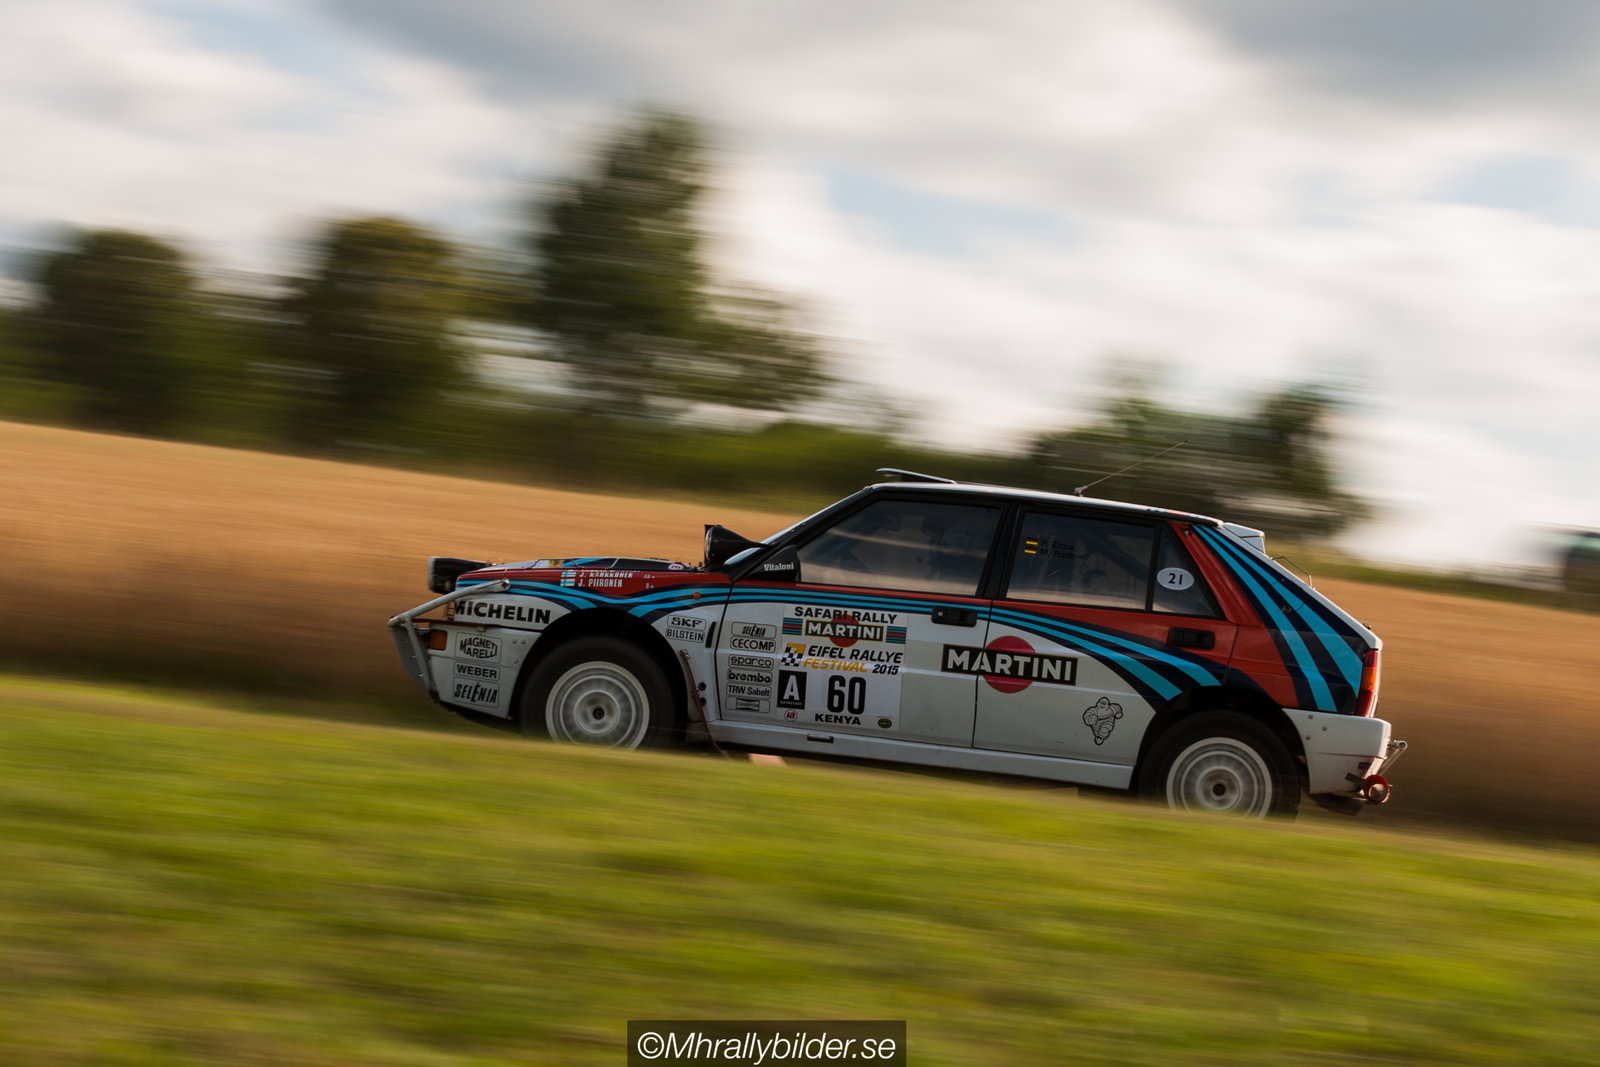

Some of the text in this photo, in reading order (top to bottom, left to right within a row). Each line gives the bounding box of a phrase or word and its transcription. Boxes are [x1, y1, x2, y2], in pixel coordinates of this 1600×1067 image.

[763, 562, 795, 572] Vitaloni
[578, 578, 586, 587] J.
[1168, 573, 1183, 585] 21
[455, 601, 551, 624] MICHELIN
[794, 606, 898, 624] SAFARI RALLY
[671, 616, 702, 628] SKF
[666, 628, 705, 641] BILSTEIN
[808, 622, 881, 640] MARTINI
[732, 638, 775, 651] CECOMP
[730, 655, 772, 667] sparco
[807, 645, 904, 664] EIFEL RALLYE
[457, 664, 497, 678] WEBER
[802, 658, 900, 676] FESTIVAL 2015
[947, 648, 1073, 682] MARTINI
[728, 670, 771, 683] brembo
[728, 684, 770, 697] TRW Sabelt
[783, 675, 800, 701] A
[827, 674, 867, 715] 60
[814, 713, 862, 726] KENYA
